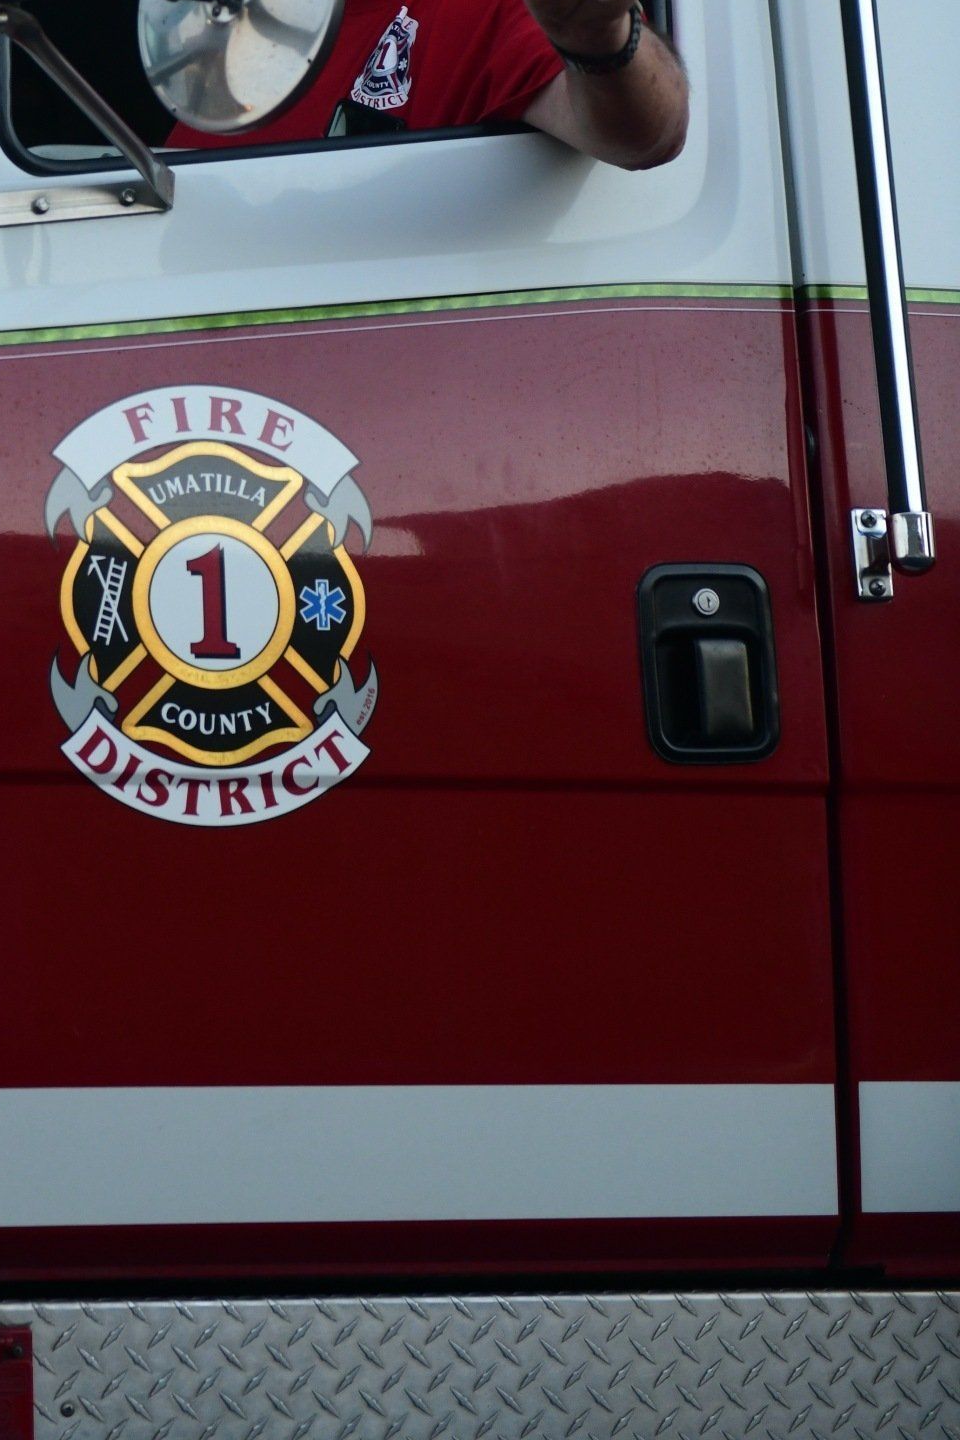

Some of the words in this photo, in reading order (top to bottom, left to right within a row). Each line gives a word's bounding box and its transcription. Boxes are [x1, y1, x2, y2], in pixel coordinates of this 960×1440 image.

[367, 80, 389, 89] COUNTY
[122, 396, 296, 452] FIRE
[148, 472, 267, 508] UMATILLA
[186, 543, 241, 659] 1
[160, 702, 276, 735] COUNTY
[75, 724, 355, 817] DISTRICT
